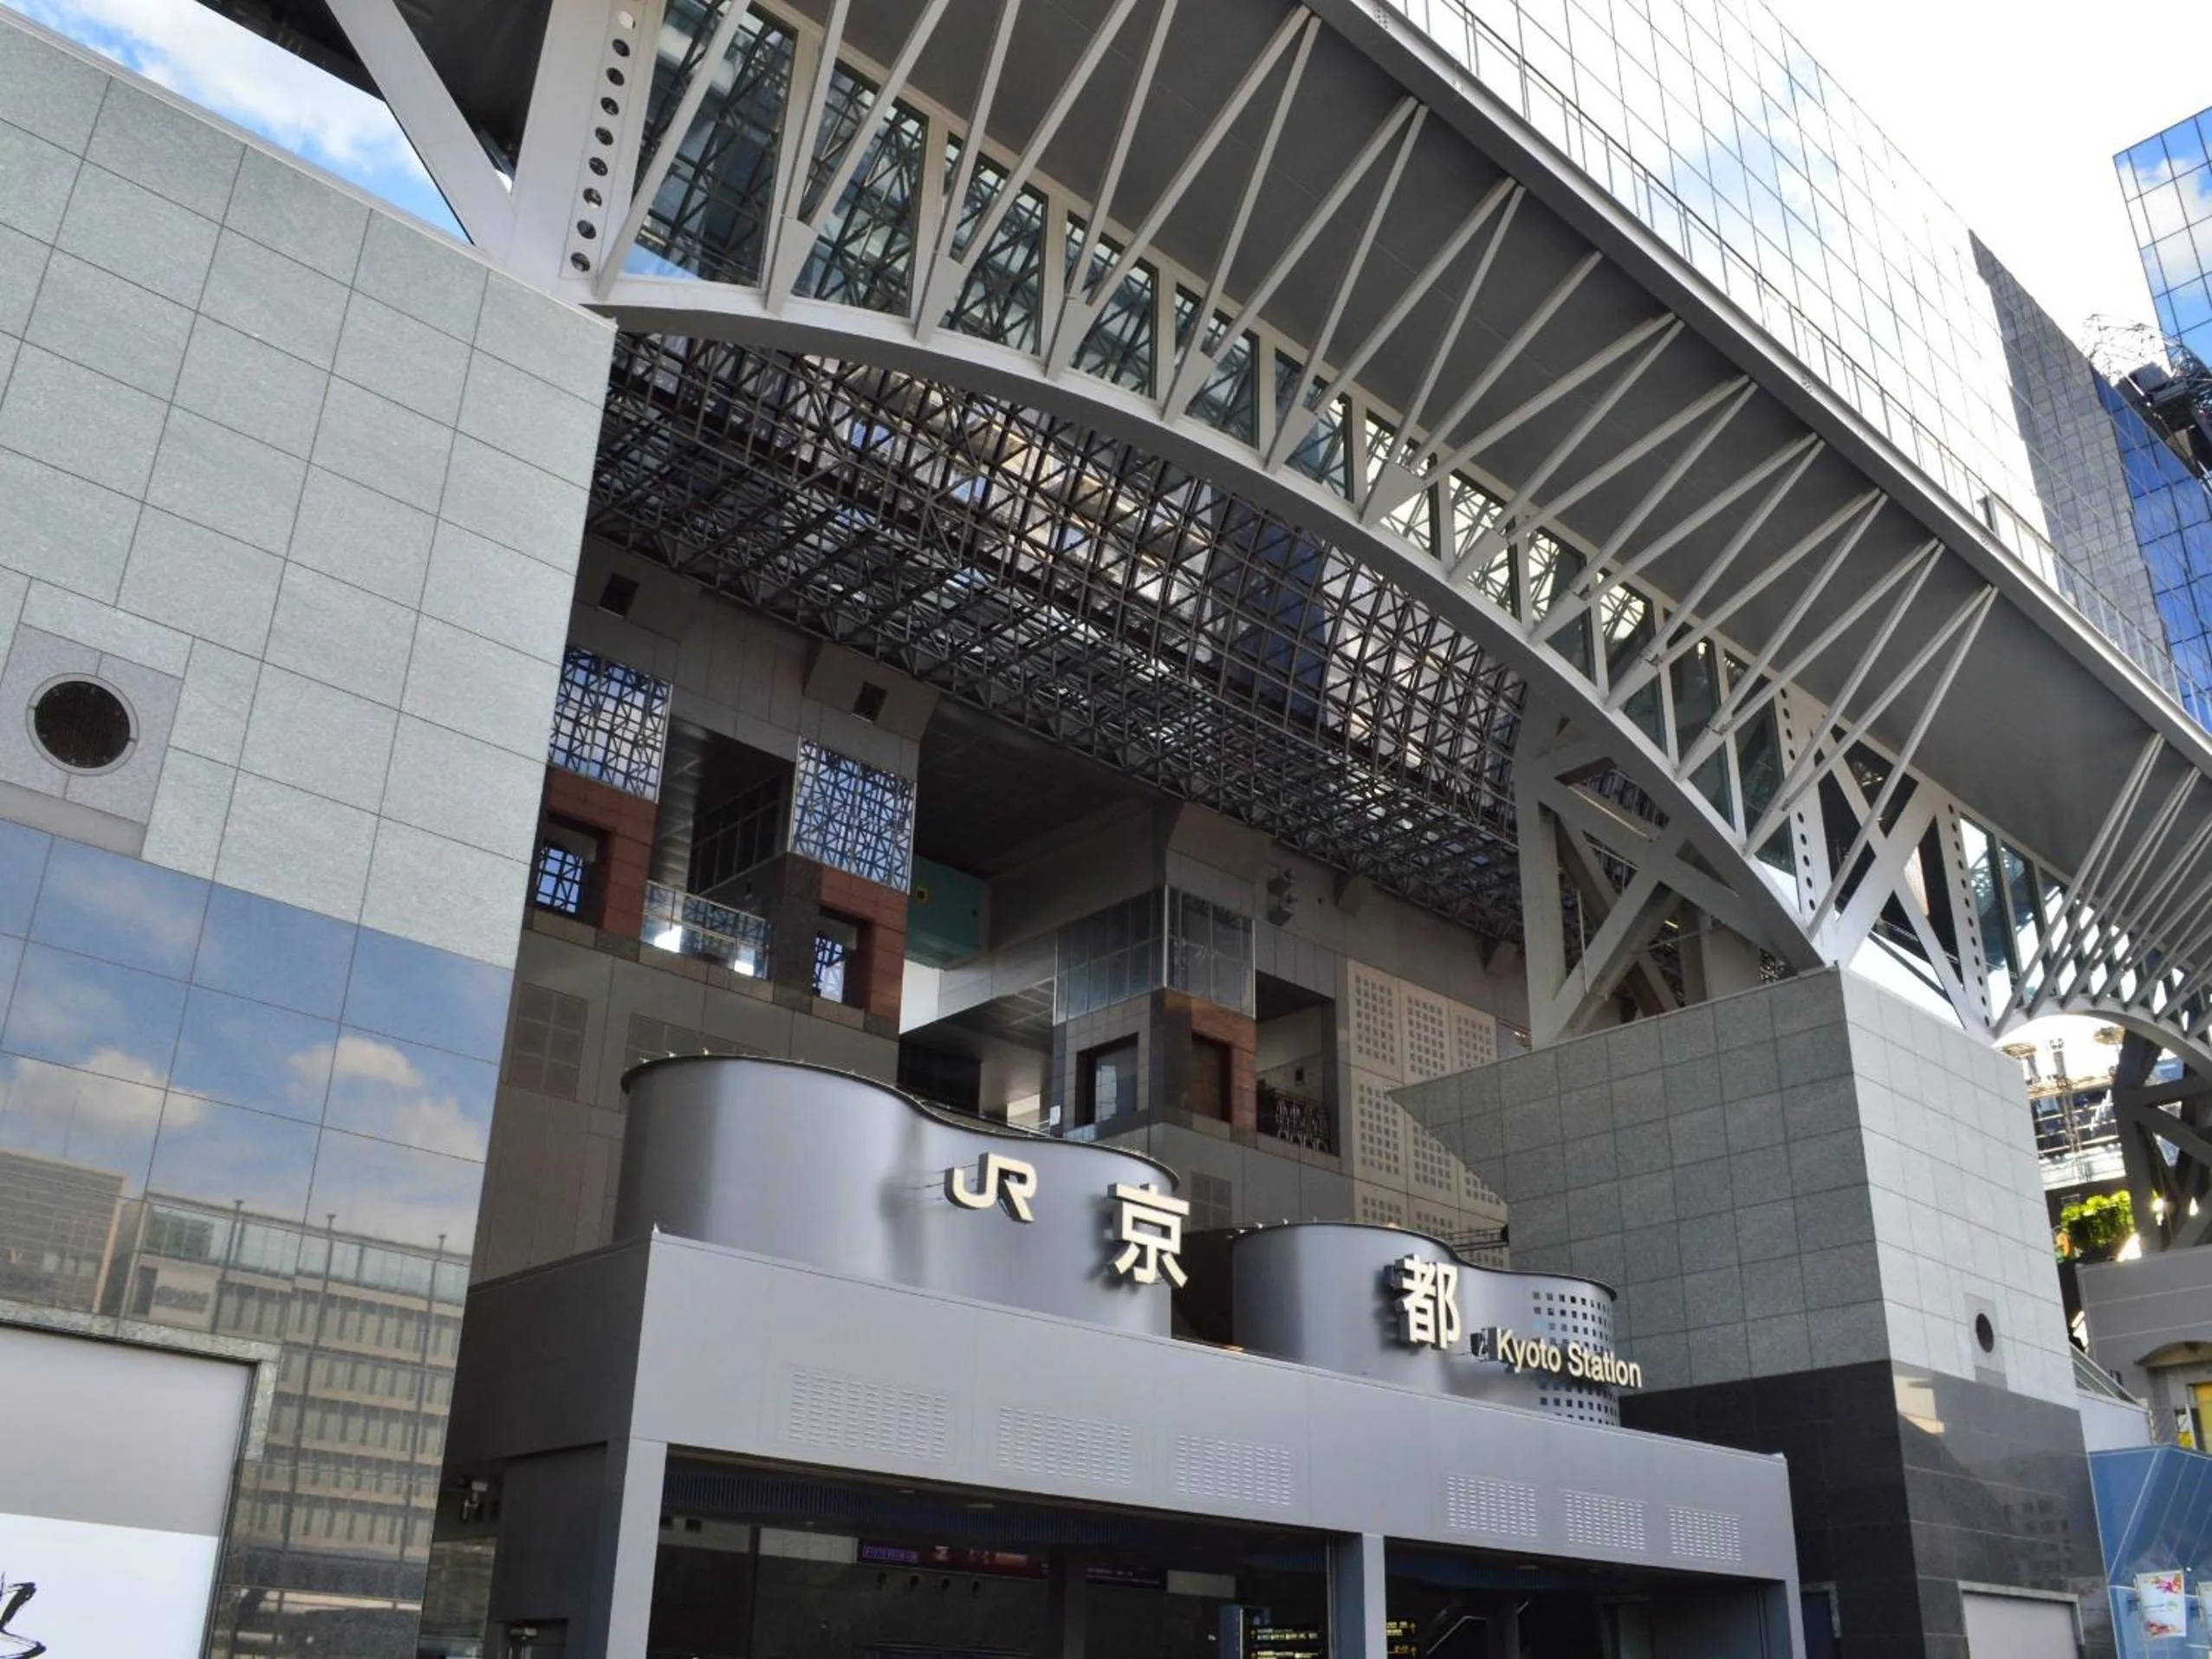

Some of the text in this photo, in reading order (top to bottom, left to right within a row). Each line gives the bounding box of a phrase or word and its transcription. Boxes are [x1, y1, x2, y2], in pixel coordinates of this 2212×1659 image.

[945, 1152, 1037, 1224] JR
[1495, 1327, 1643, 1389] Kyoto Station
